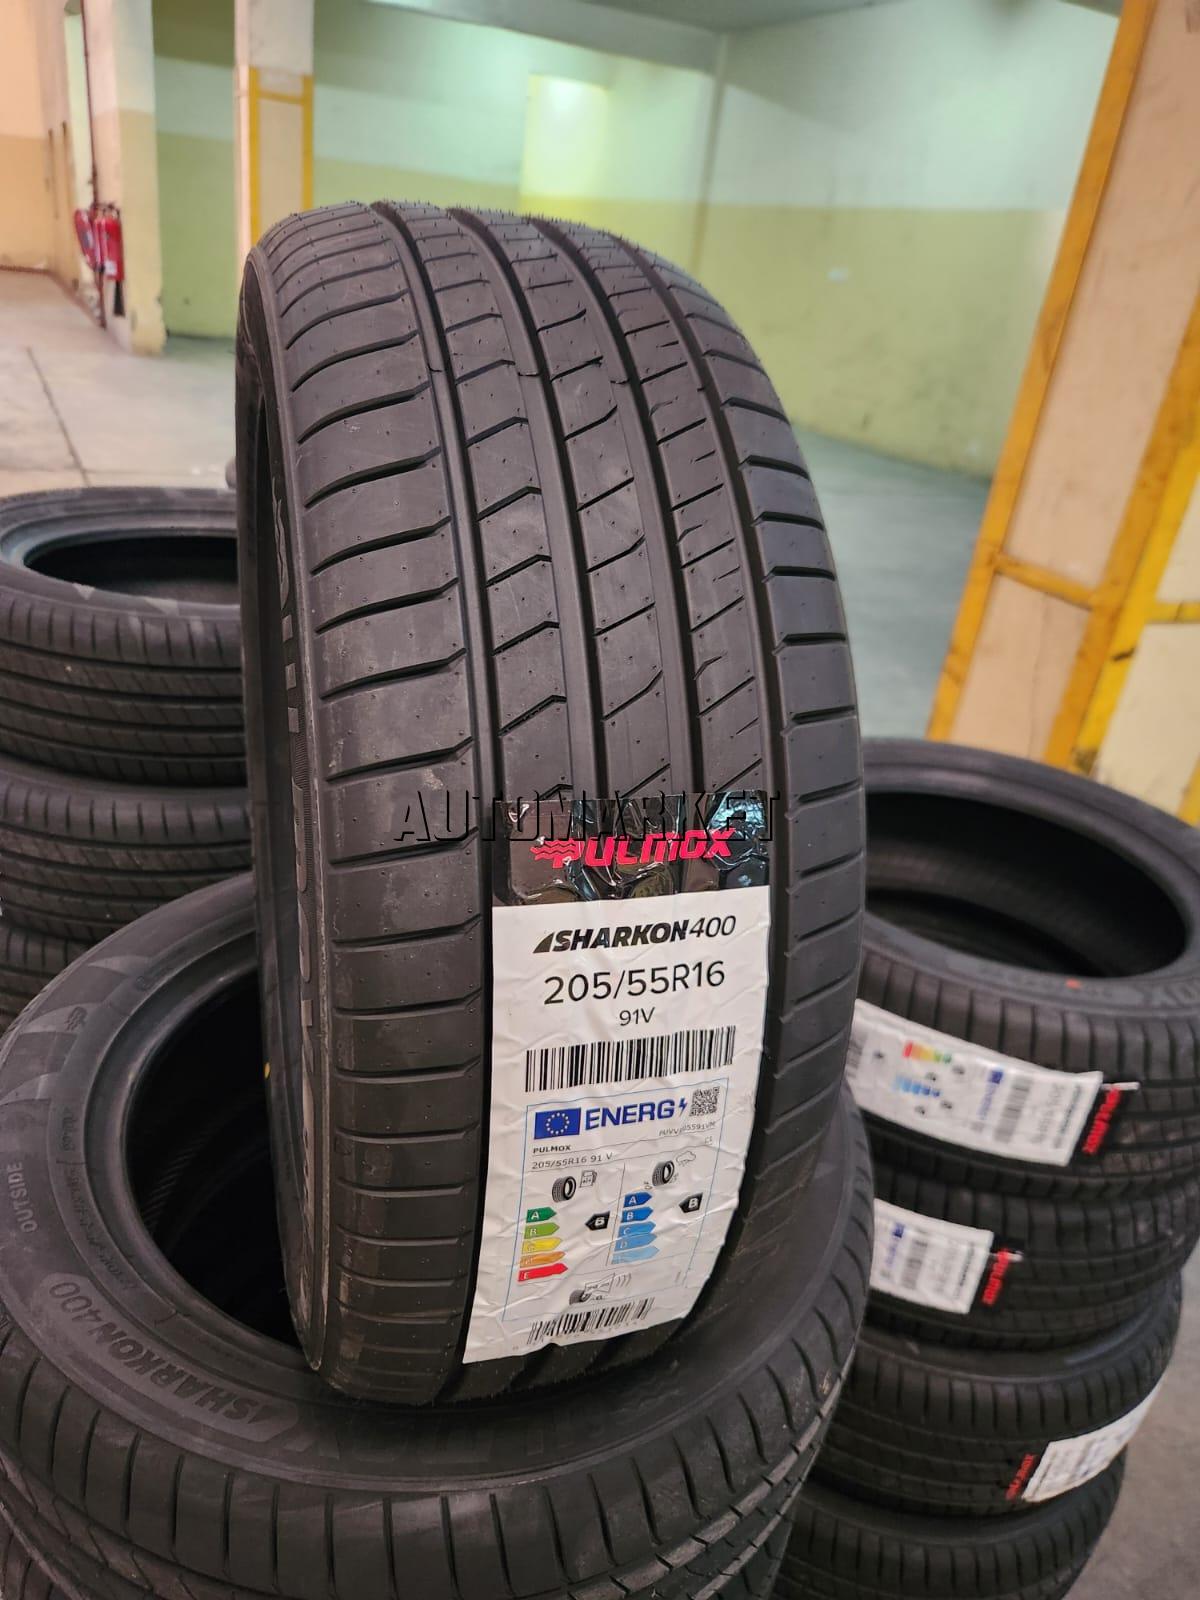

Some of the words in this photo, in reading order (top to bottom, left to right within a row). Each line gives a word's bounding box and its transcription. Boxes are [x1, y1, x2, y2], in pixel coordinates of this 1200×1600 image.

[543, 960, 726, 1005] 205/55R16
[618, 1006, 656, 1027] 91V
[584, 1098, 676, 1131] ENERG
[533, 1144, 571, 1154] PULMOX
[532, 1155, 587, 1170] 205/55R16
[590, 1154, 602, 1163] 91
[7, 1162, 38, 1233] OUTSIDE
[629, 1196, 637, 1205] A
[688, 1198, 698, 1209] B
[531, 1211, 540, 1220] A
[627, 1212, 634, 1221] B
